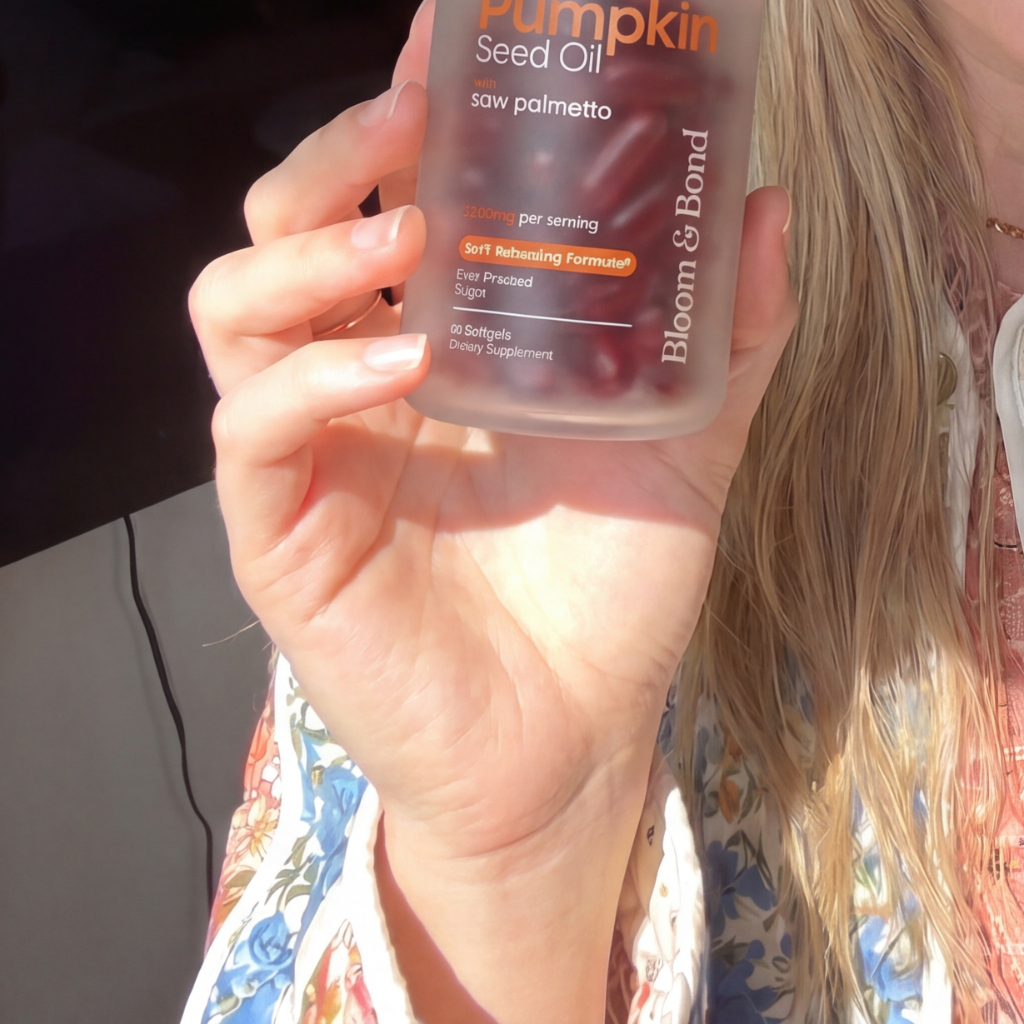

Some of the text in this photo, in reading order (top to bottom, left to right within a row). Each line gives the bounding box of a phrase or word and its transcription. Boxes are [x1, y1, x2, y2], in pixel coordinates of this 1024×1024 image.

[476, 34, 602, 74] Seed Oil
[471, 92, 612, 120] saw palmetto
[518, 212, 543, 227] per
[661, 128, 709, 365] Bloom & Bond
[486, 343, 553, 361] Supplement
